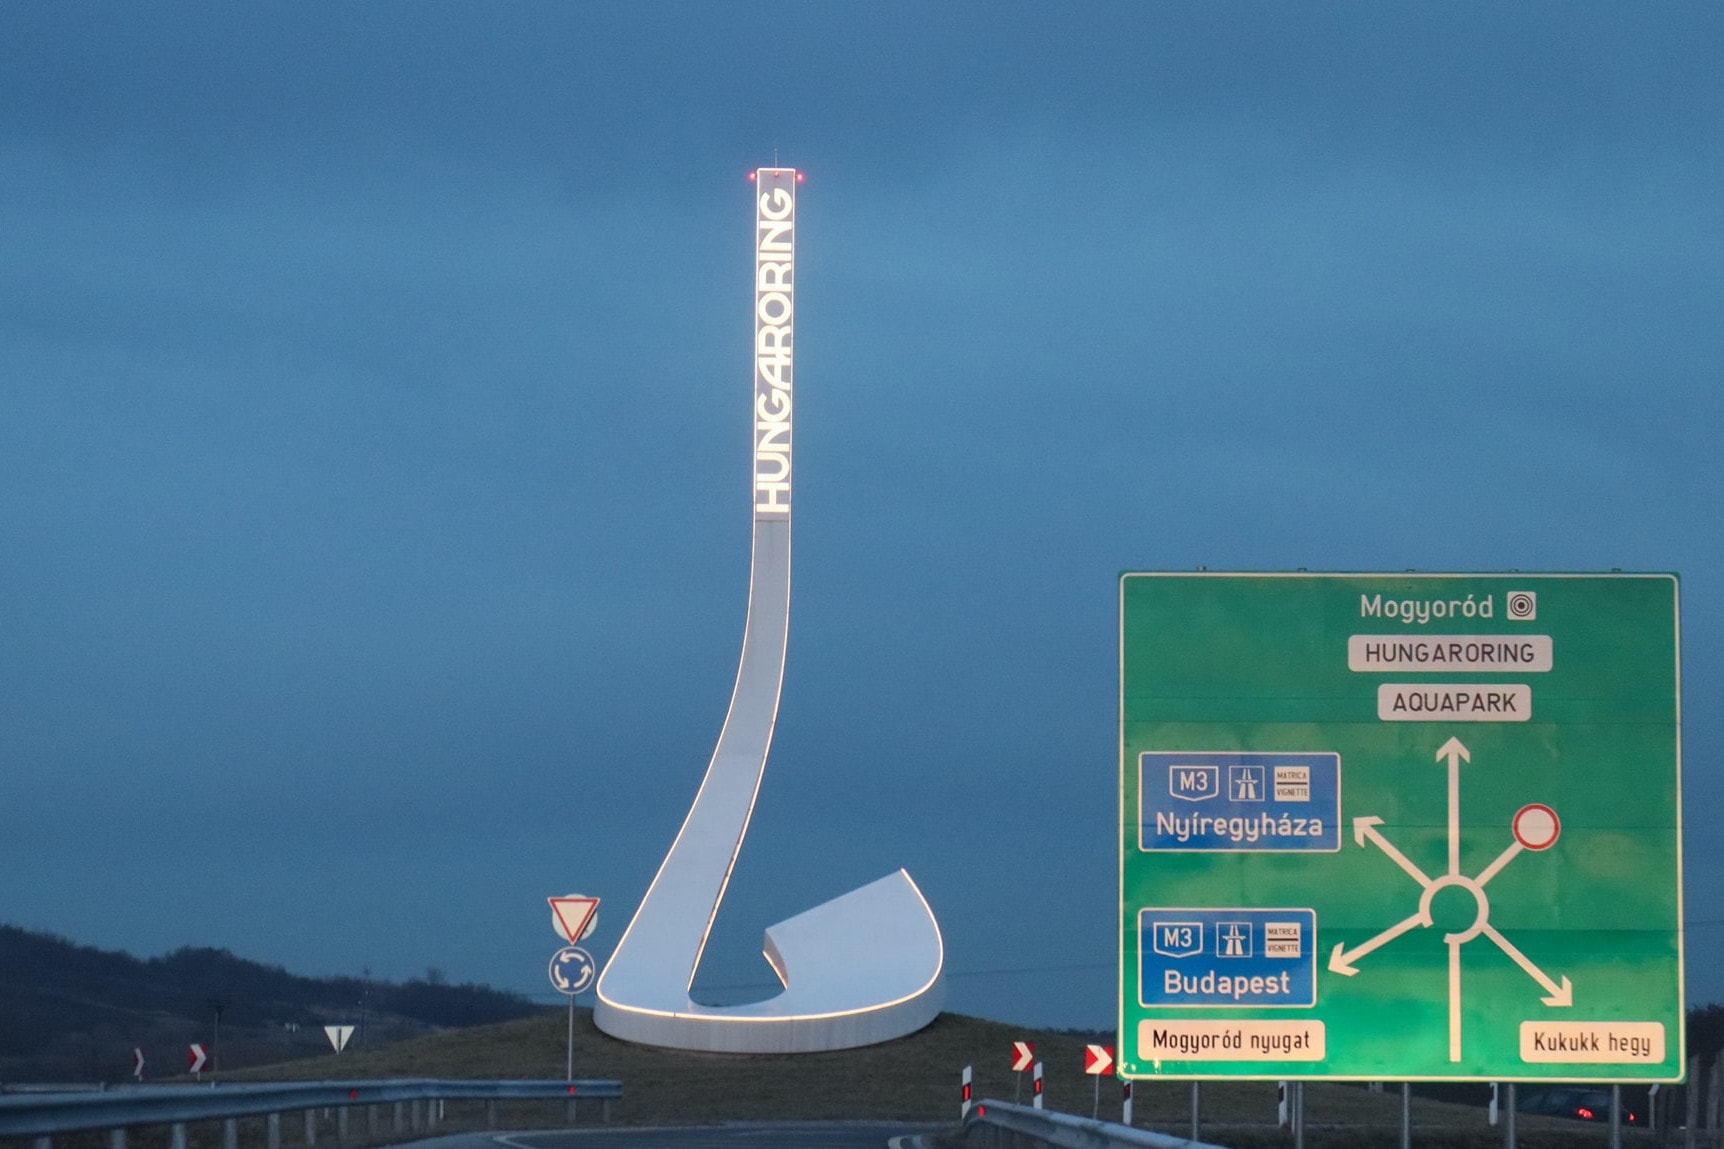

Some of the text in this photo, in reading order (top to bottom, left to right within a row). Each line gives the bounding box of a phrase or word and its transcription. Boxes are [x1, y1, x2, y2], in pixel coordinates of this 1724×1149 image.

[756, 187, 793, 514] HUNGARORING
[1360, 594, 1494, 624] Mogyoród
[1366, 643, 1535, 663] HUNGARORING
[1392, 693, 1517, 712] AQUAPARK
[1180, 771, 1208, 791] M3
[1276, 771, 1307, 780] MATRICA
[1276, 788, 1308, 797] VIGNETTE
[1156, 811, 1323, 842] Nyíregyháza
[1164, 927, 1192, 948] M3
[1267, 928, 1298, 936] MATRICA
[1267, 944, 1299, 953] VIGNETTE
[1164, 970, 1291, 1000] Budapest
[1153, 1029, 1310, 1054] Mogyoród nyugat
[1534, 1032, 1650, 1056] Kukukk hegy
